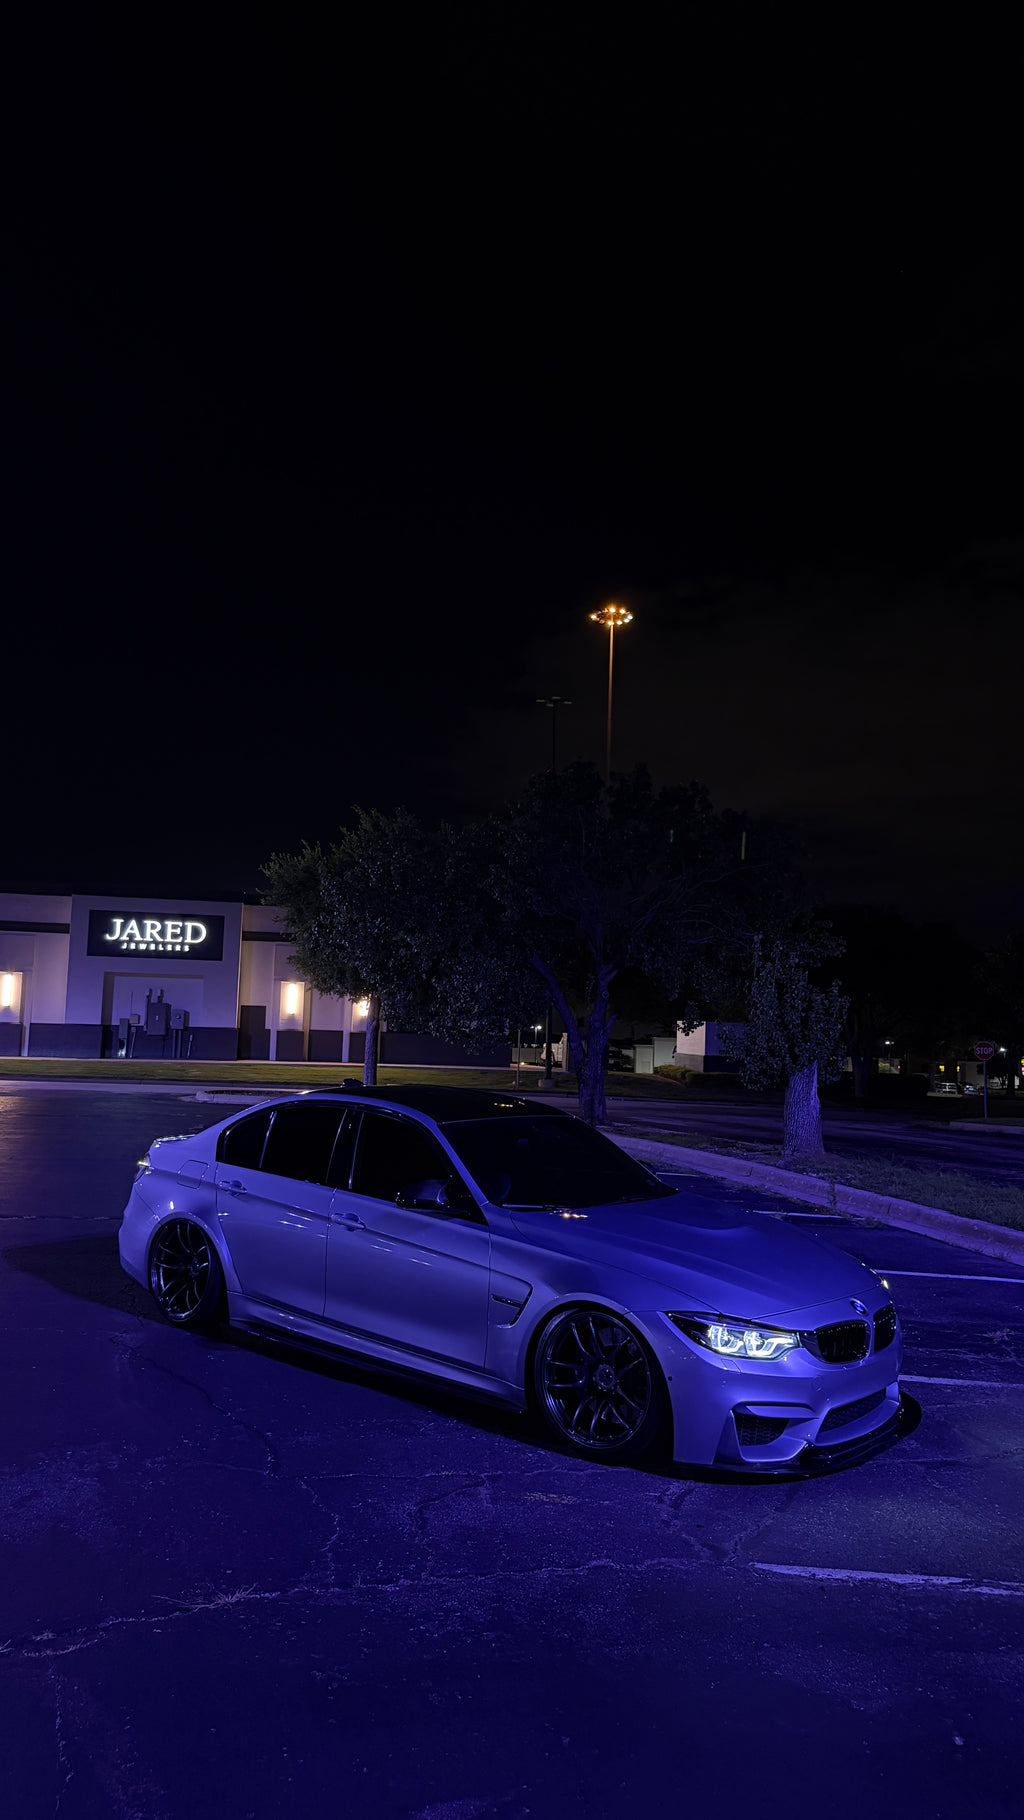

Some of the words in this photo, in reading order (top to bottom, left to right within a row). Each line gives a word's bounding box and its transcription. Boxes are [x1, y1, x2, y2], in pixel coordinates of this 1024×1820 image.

[104, 918, 207, 944] JARED
[121, 942, 190, 952] JEWELERS
[975, 1047, 993, 1055] STOP
